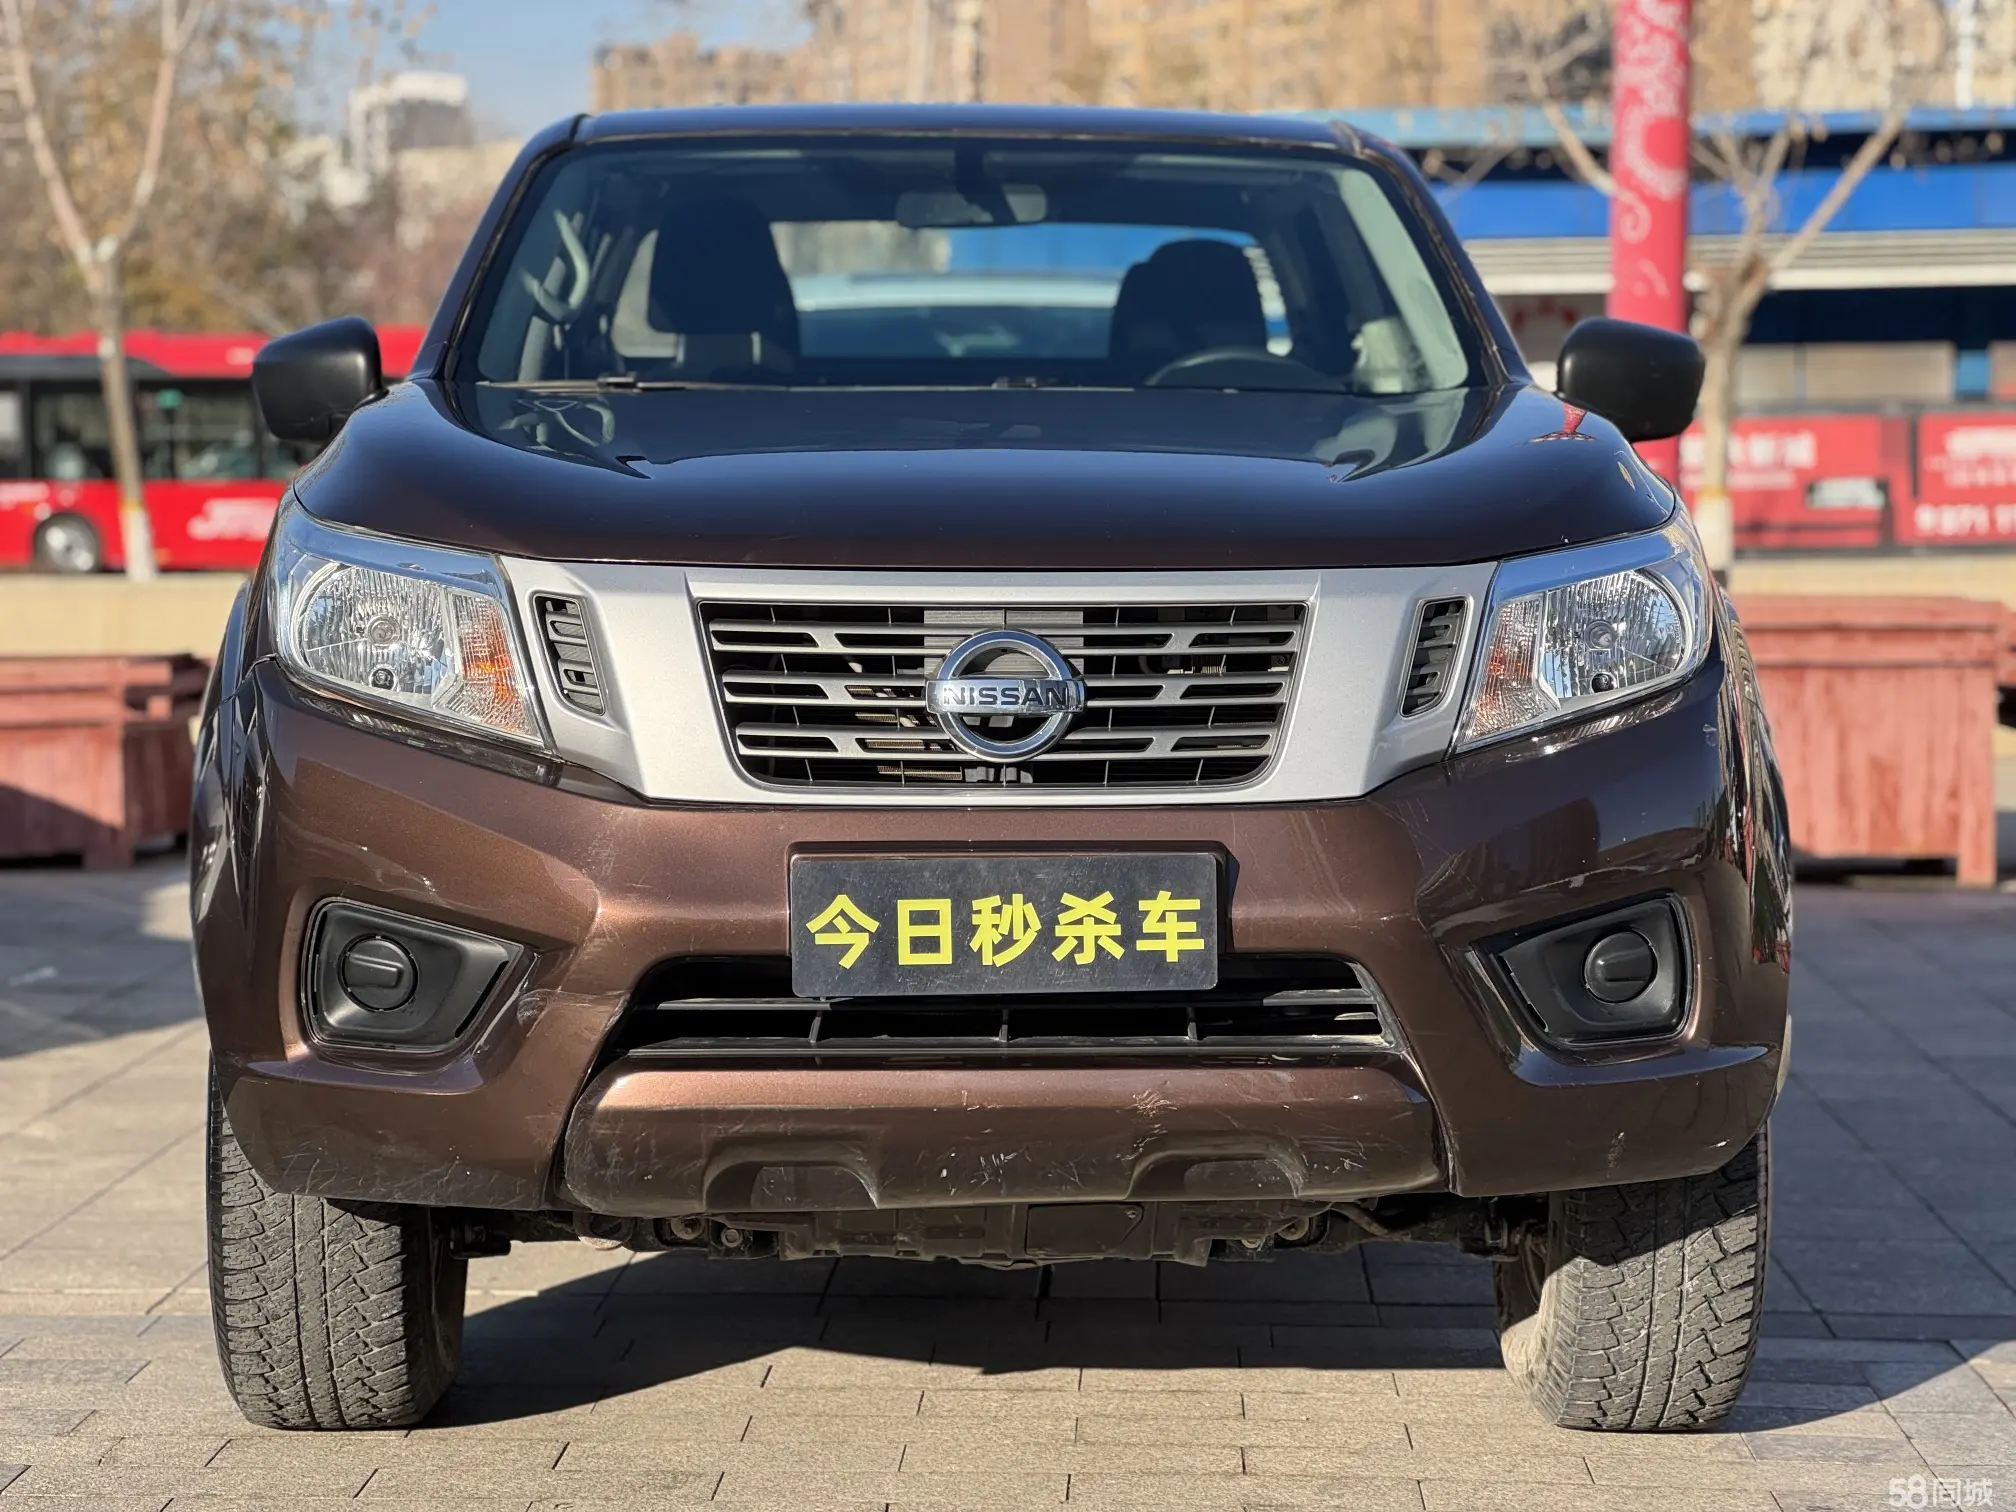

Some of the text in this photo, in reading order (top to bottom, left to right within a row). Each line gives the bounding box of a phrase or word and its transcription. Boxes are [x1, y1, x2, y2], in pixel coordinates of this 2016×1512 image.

[942, 686, 1068, 706] NISSAN
[806, 891, 1205, 969] 今日秒杀车
